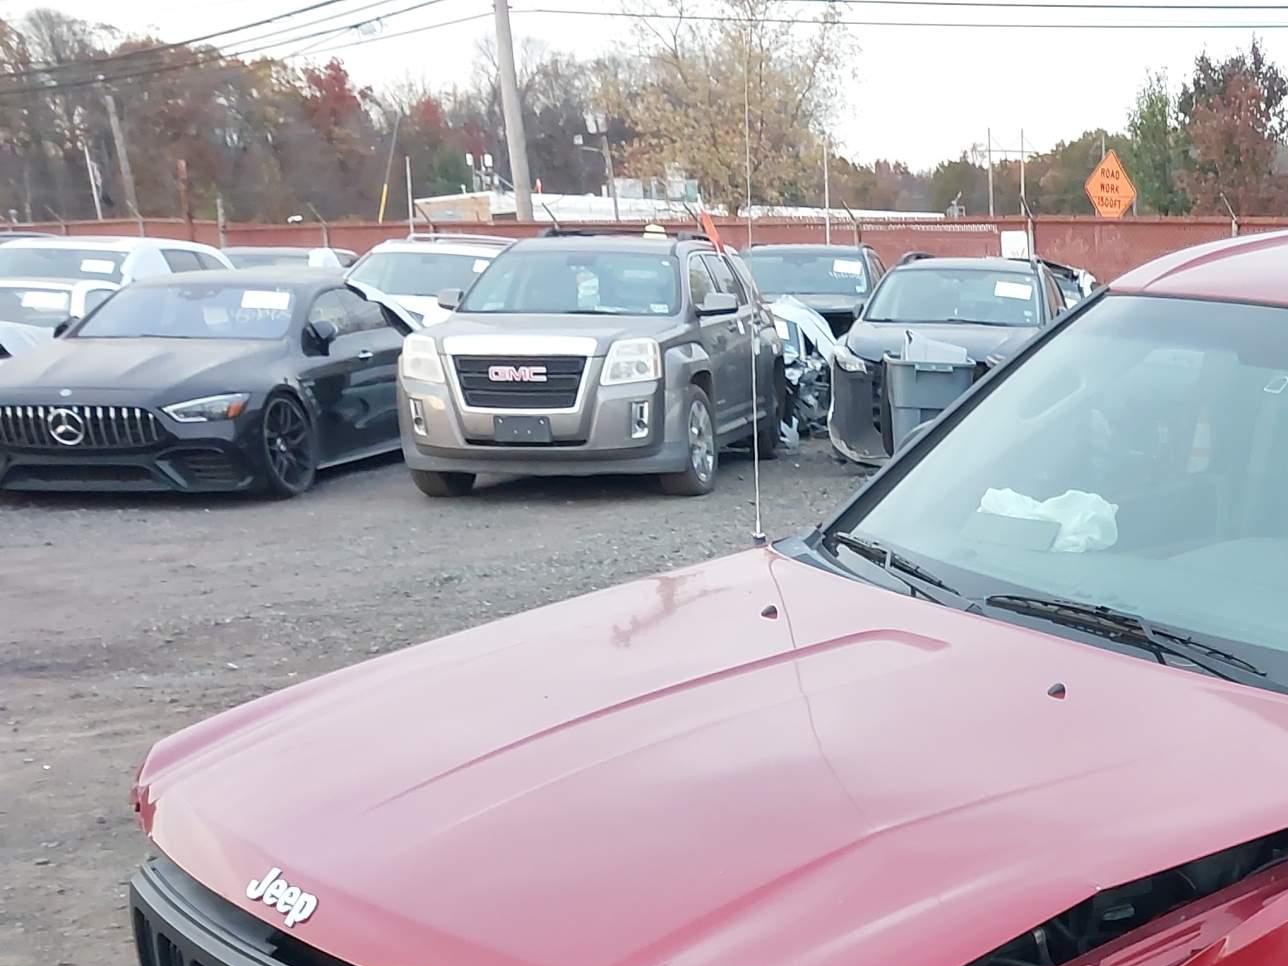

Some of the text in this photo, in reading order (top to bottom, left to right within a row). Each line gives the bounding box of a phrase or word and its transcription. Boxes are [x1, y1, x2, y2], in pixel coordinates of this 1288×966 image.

[1100, 167, 1120, 180] ROAD
[1100, 183, 1120, 194] WORK
[488, 365, 548, 382] GMC
[246, 867, 320, 929] Jeep
